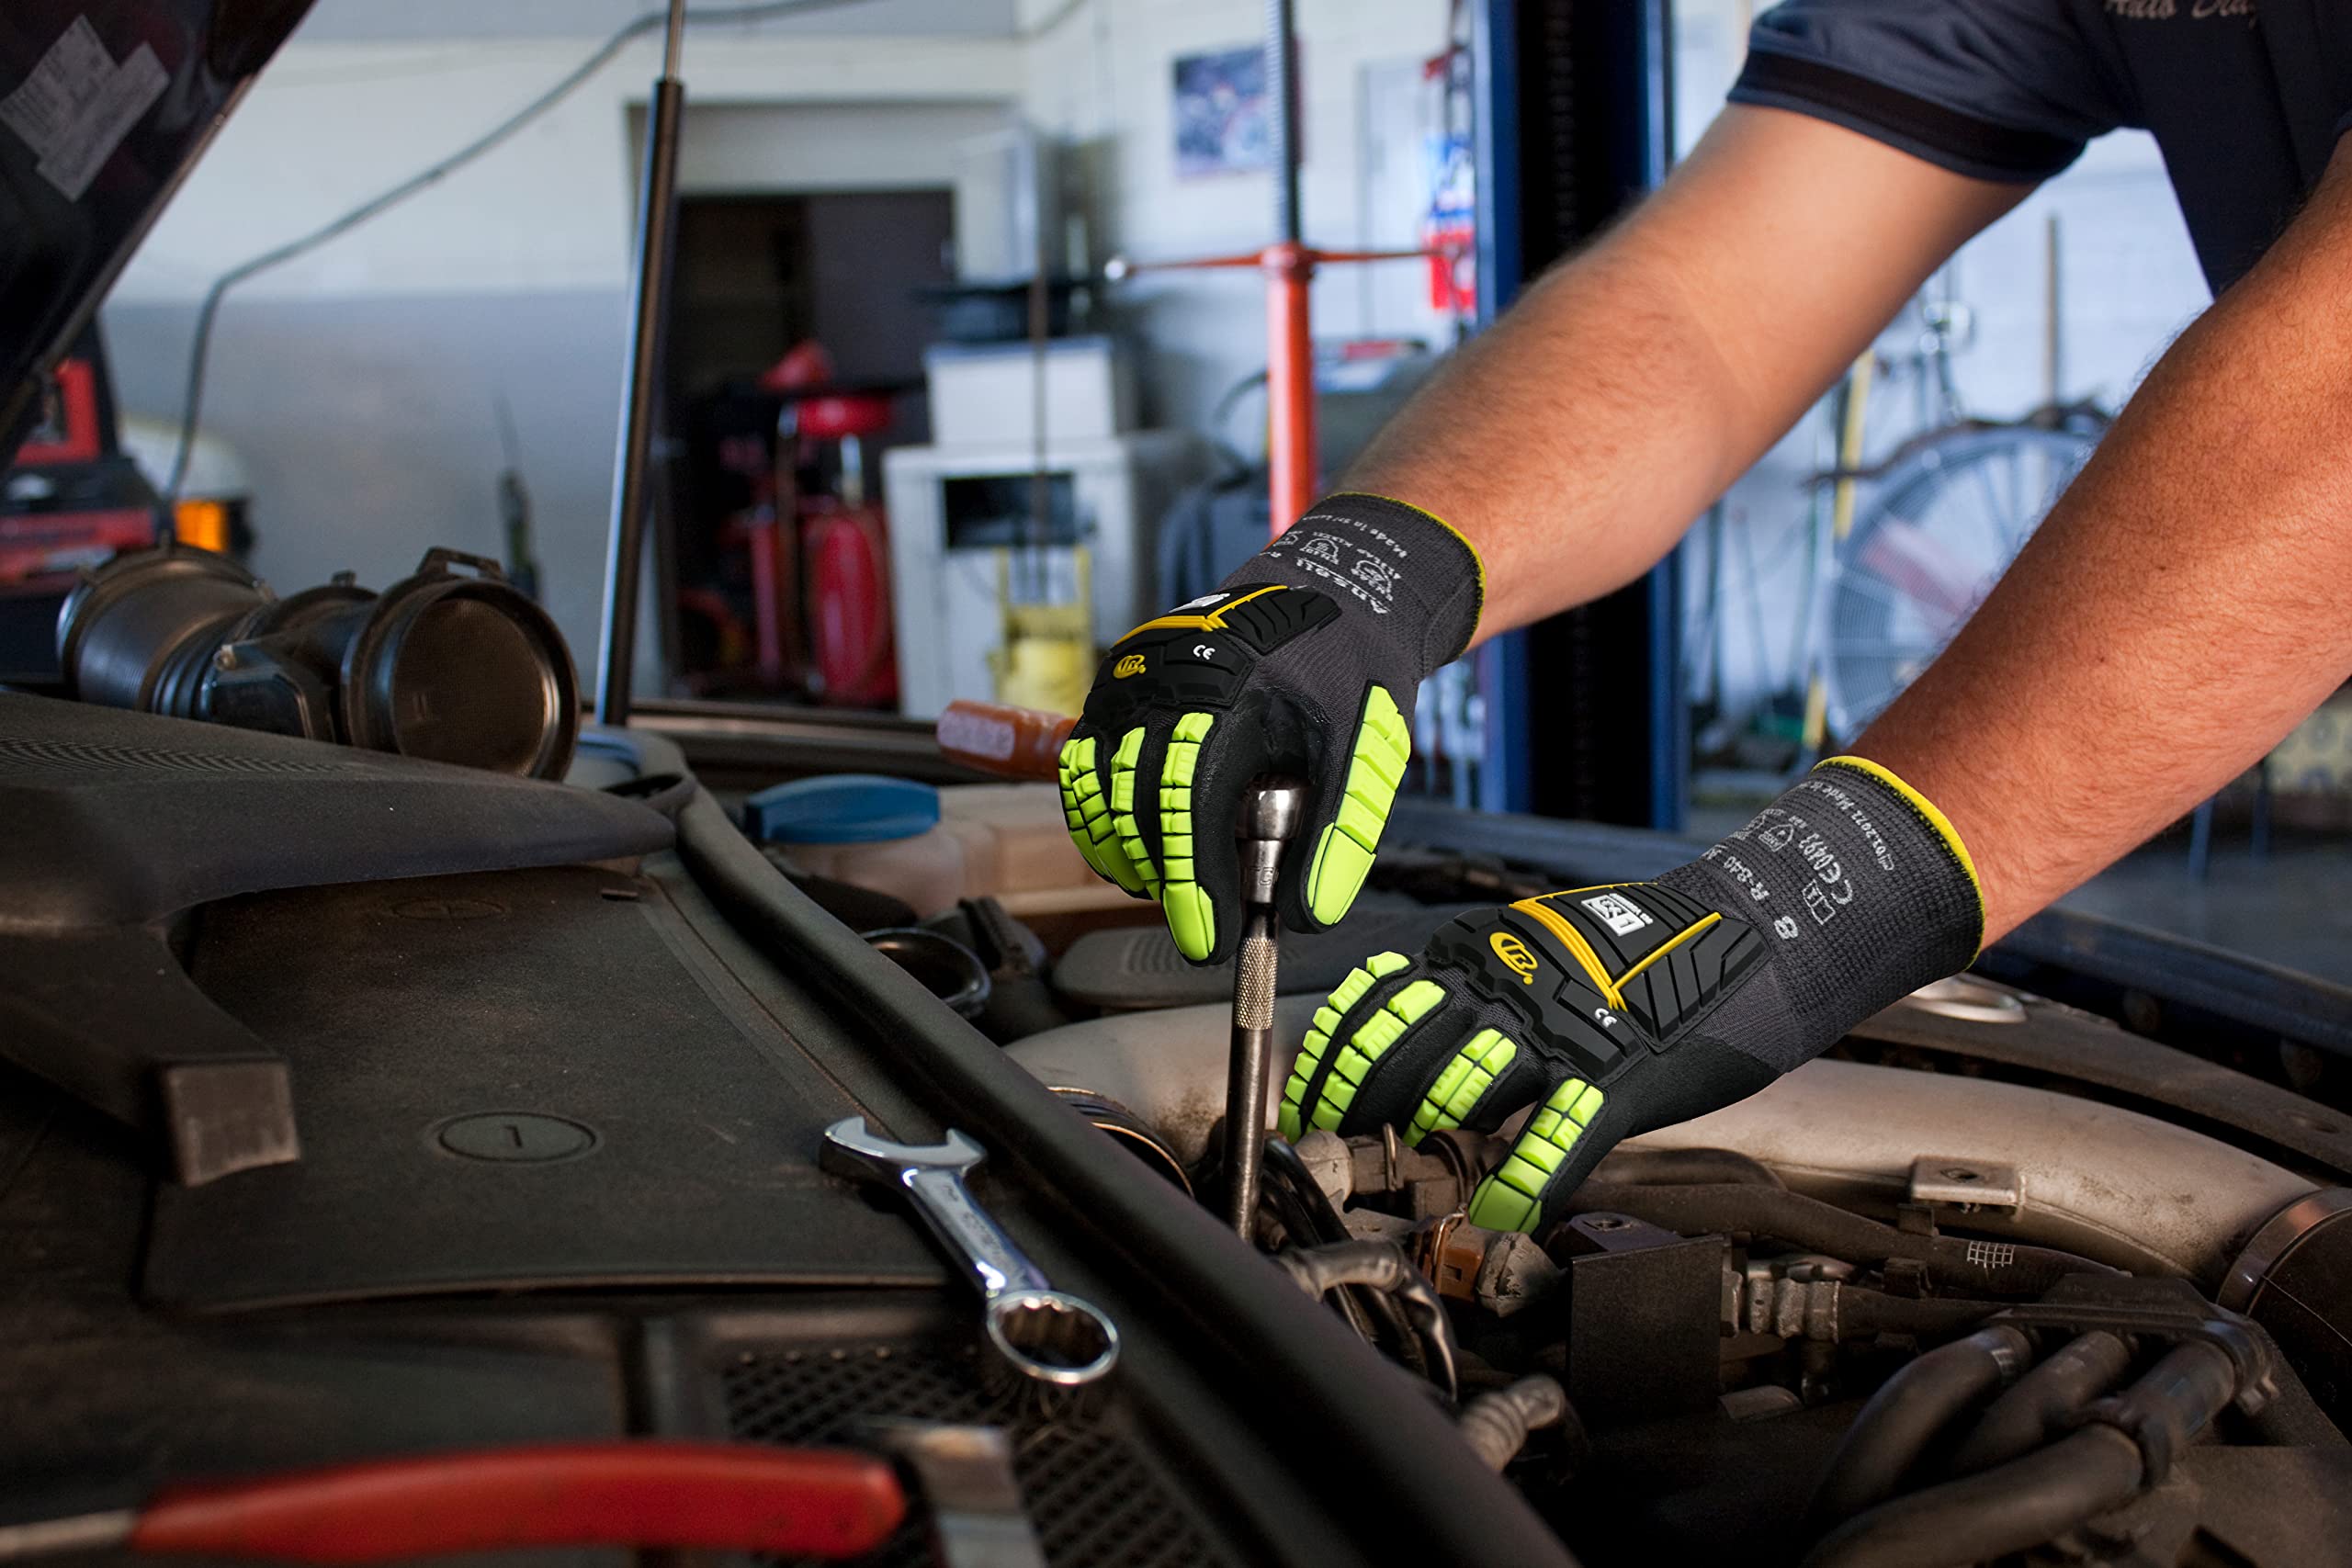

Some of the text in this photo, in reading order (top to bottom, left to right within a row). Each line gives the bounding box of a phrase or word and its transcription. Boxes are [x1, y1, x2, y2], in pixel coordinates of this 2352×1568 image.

[1296, 558, 1387, 614] Ansell
[1193, 645, 1216, 660] CE
[1724, 856, 1770, 903] R-840
[1774, 916, 1799, 939] 8
[1595, 1008, 1617, 1028] CE
